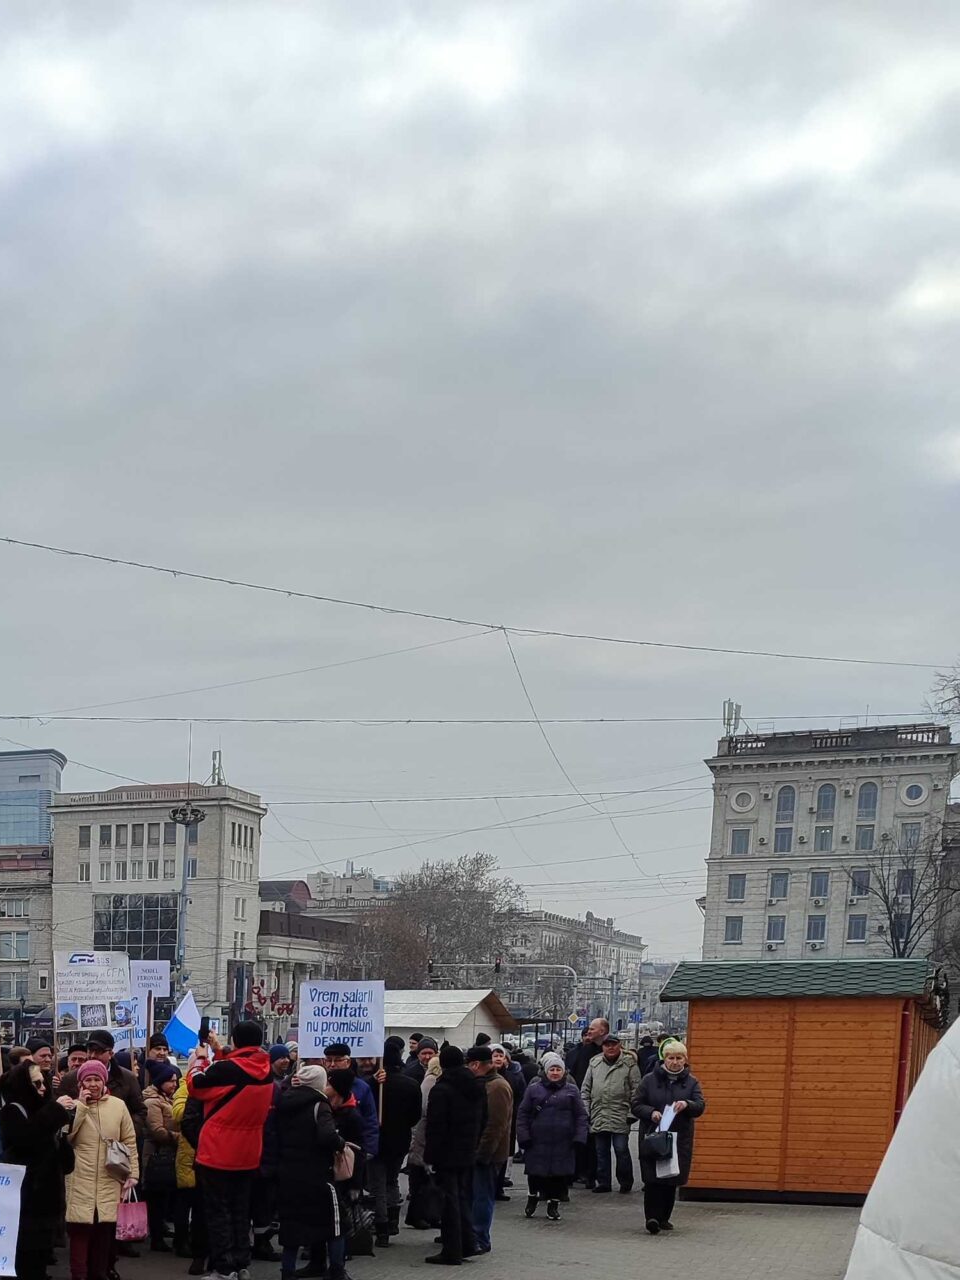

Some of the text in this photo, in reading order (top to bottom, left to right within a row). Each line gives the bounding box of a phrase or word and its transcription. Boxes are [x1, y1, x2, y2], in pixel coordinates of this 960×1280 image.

[309, 988, 373, 1003] Vrem salarii
[313, 1003, 369, 1018] achitate
[306, 1020, 373, 1035] nu promisiuni
